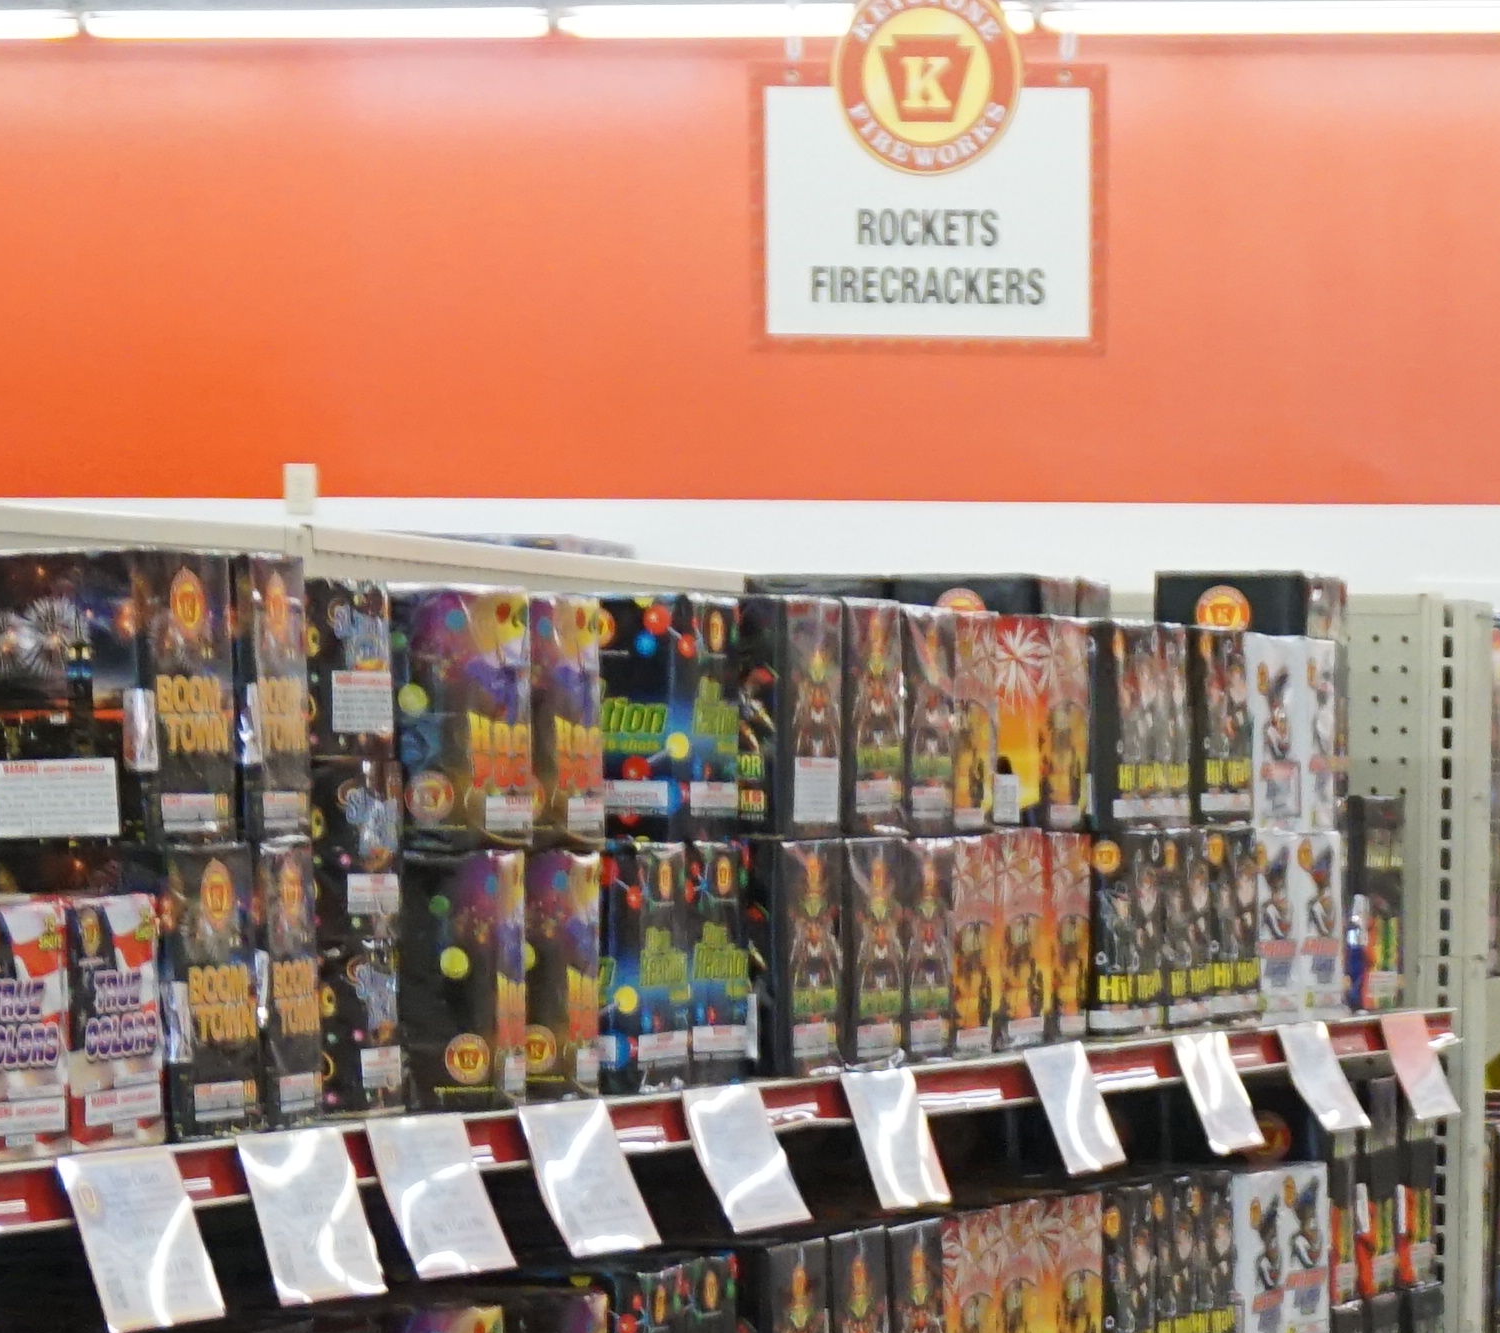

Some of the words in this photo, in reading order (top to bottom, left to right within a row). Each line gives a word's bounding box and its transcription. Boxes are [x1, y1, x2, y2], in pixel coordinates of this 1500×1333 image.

[902, 56, 952, 112] K
[848, 101, 1007, 166] FIREWORKS
[857, 208, 1000, 246] ROCKETS
[811, 265, 1046, 306] FIRECRACKERS
[155, 674, 223, 714] BOOM
[163, 712, 229, 754] TOWN
[93, 970, 143, 1013] TRUE
[84, 1010, 160, 1063] COLORS
